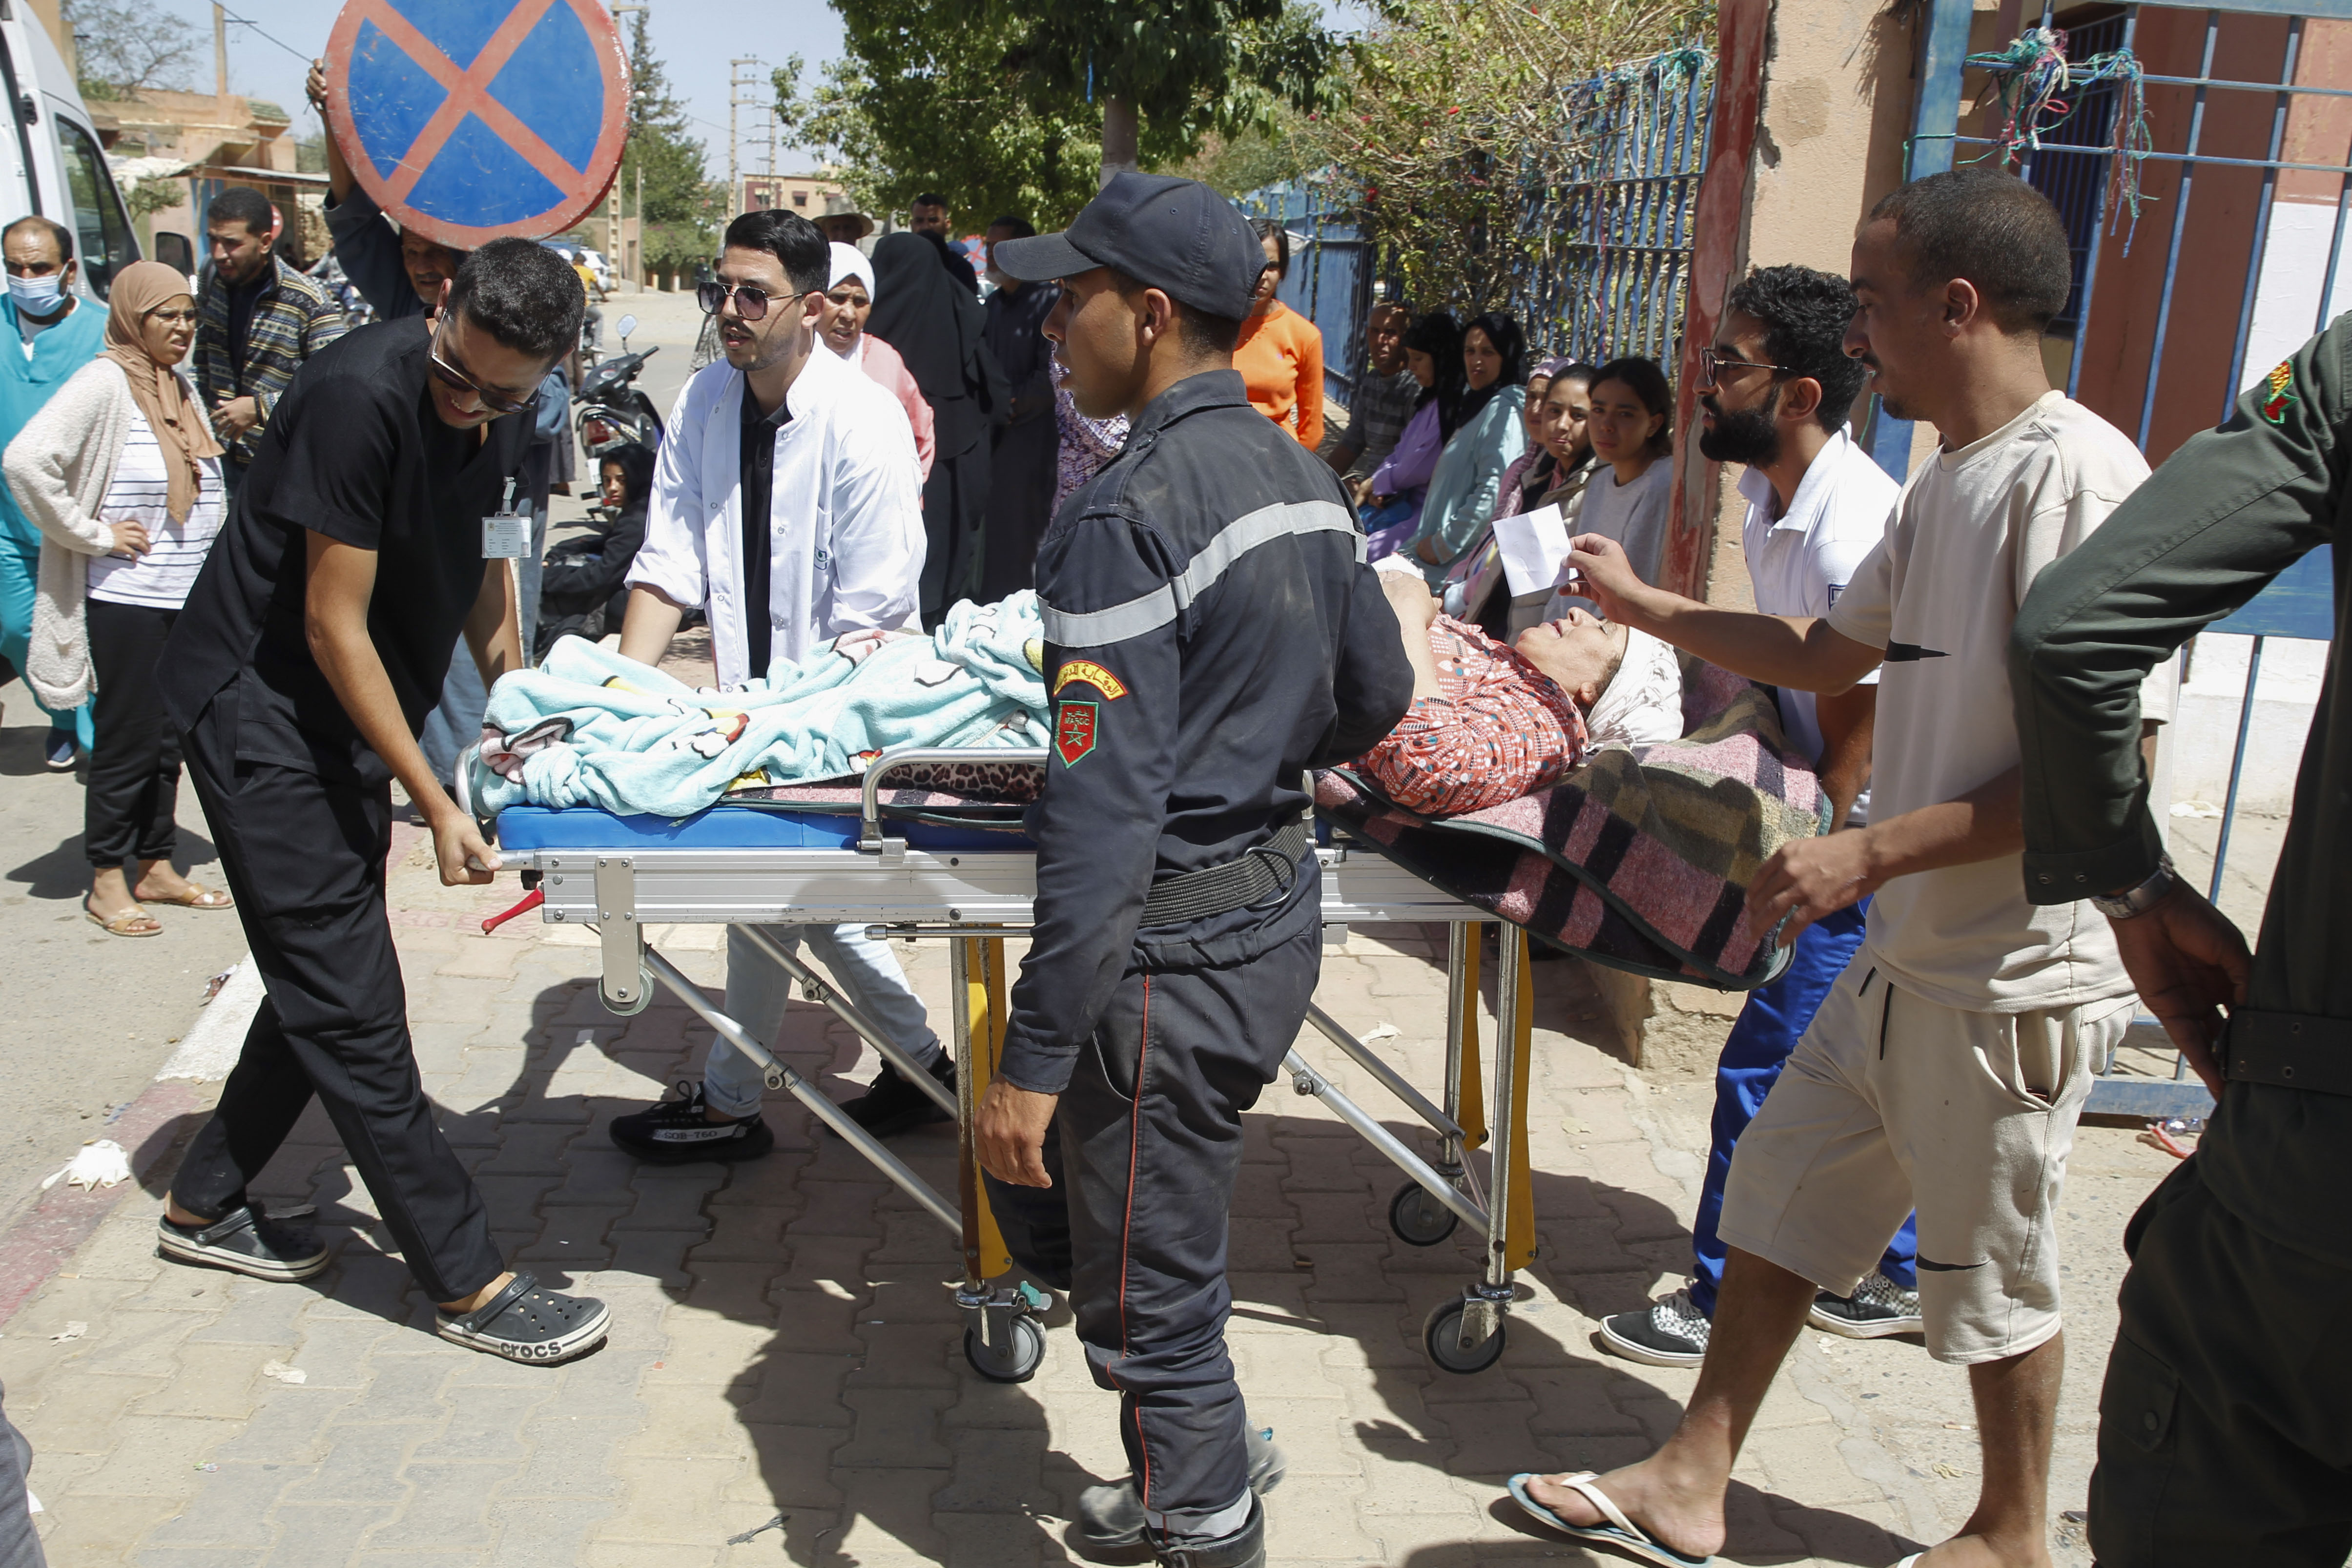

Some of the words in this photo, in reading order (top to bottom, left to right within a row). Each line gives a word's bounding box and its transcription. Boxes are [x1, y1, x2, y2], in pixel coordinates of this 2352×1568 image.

[1081, 664, 1120, 696] الوقاية
[1064, 717, 1090, 726] MAROC
[500, 1341, 561, 1359] crocs
